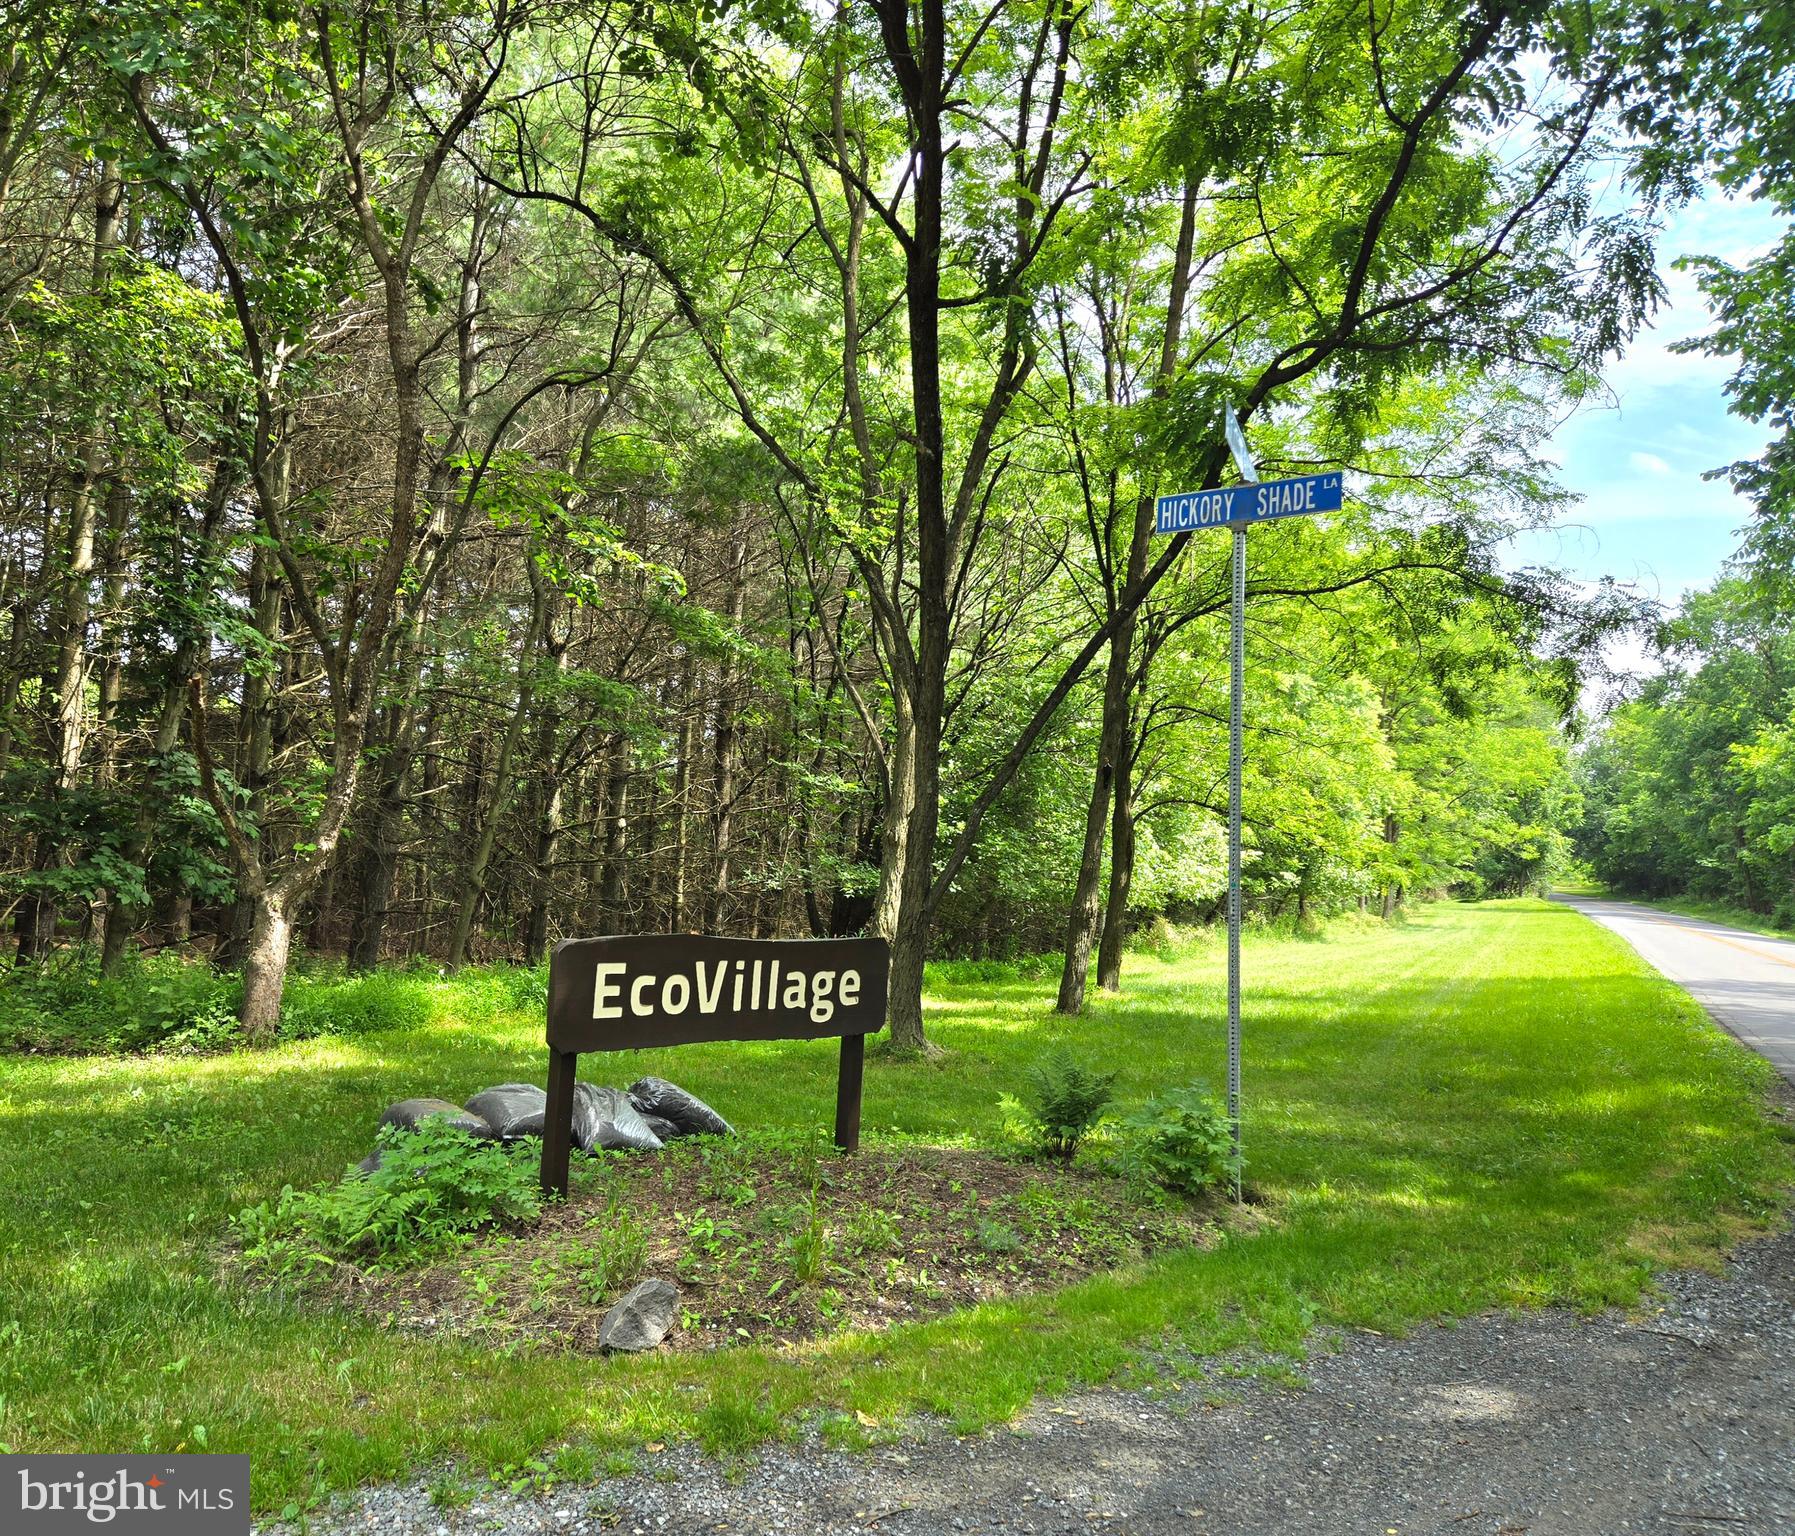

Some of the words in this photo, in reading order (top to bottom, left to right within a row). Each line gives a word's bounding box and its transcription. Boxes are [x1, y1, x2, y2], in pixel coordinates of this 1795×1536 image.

[1161, 492, 1236, 529] HICKORY
[1256, 481, 1316, 517] SHADE
[1323, 478, 1338, 489] LA
[593, 960, 861, 1023] EcoVillage
